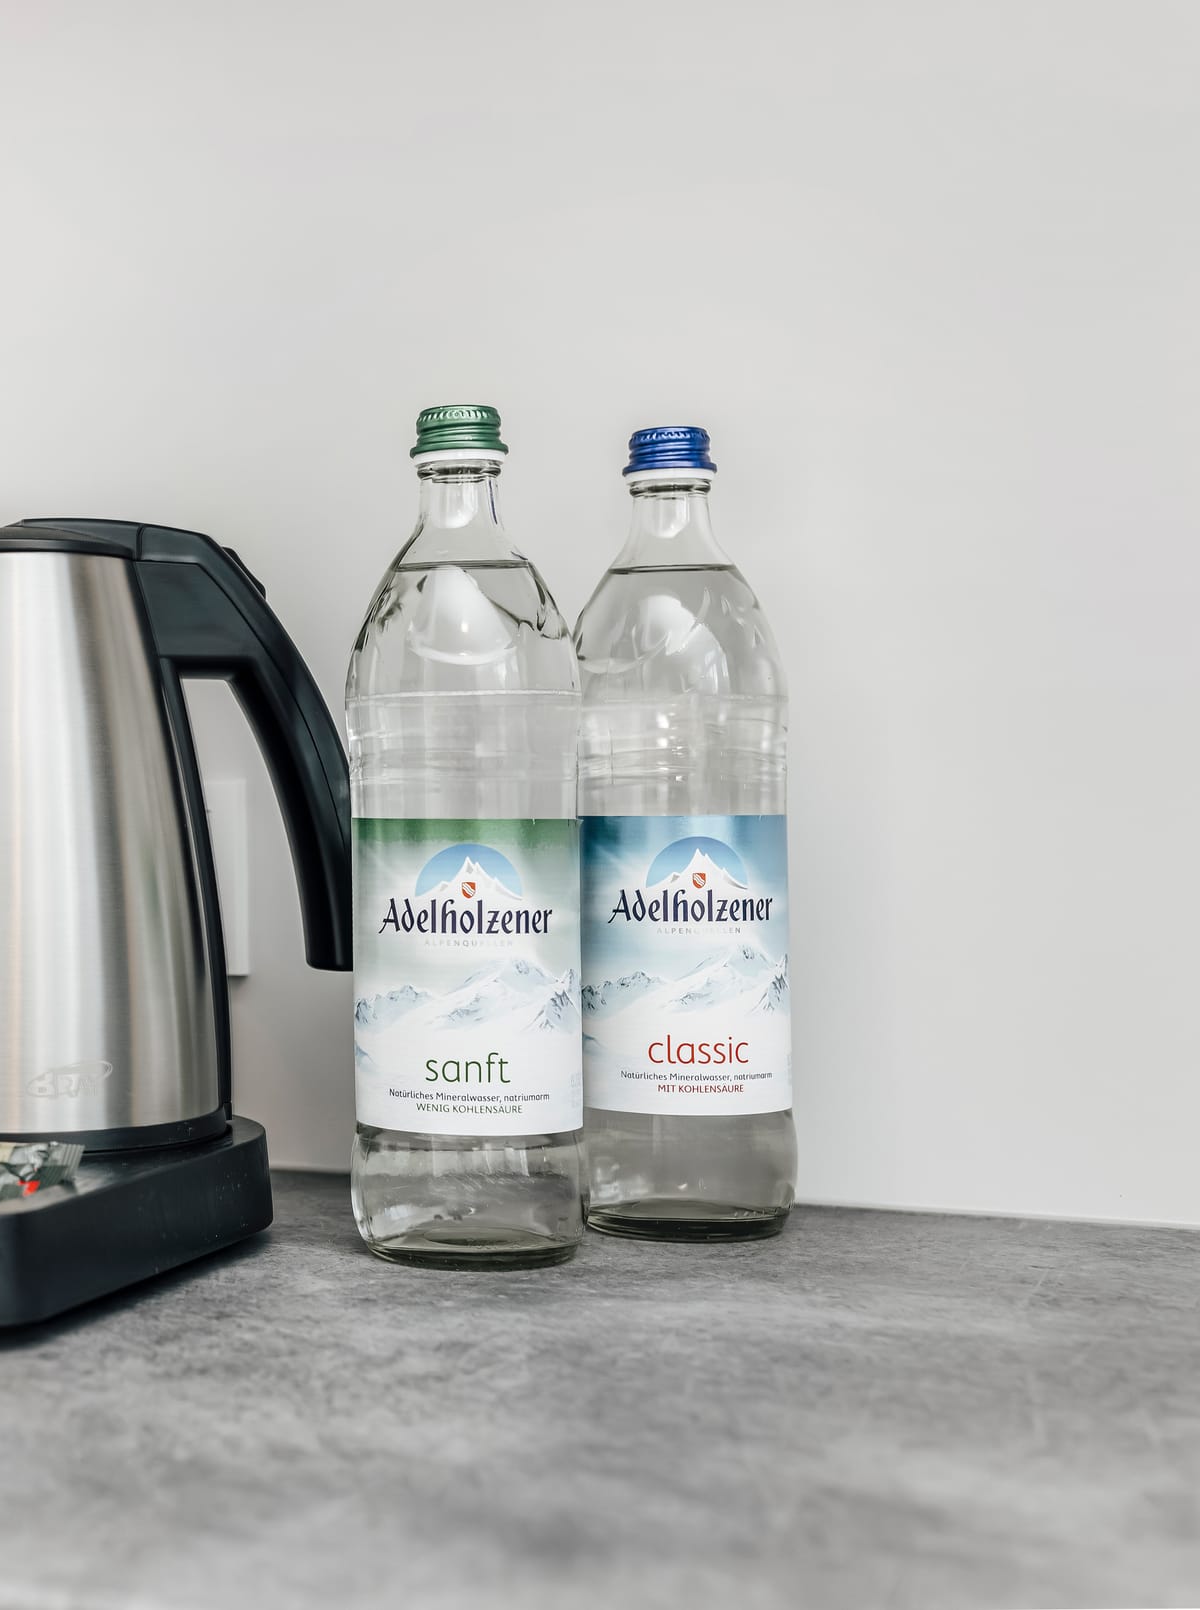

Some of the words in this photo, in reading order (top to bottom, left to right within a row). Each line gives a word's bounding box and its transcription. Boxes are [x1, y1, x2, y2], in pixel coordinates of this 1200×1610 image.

[378, 898, 553, 934] Adelholzener
[608, 889, 773, 923] Adelholzener
[648, 1034, 749, 1064] classic
[425, 1052, 511, 1083] sanft
[620, 1070, 668, 1081] Natürliches
[669, 1072, 732, 1082] Mineralwasser,
[733, 1071, 773, 1081] natriumarm
[389, 1088, 434, 1100] Natürliches
[435, 1091, 502, 1104] Mineralwasser,
[504, 1092, 550, 1103] natriumarm
[657, 1084, 676, 1093] MIT
[678, 1082, 744, 1093] KOHLENSÄURE
[416, 1103, 450, 1113] WENIG
[452, 1102, 523, 1114] KOHLENSÄURE
